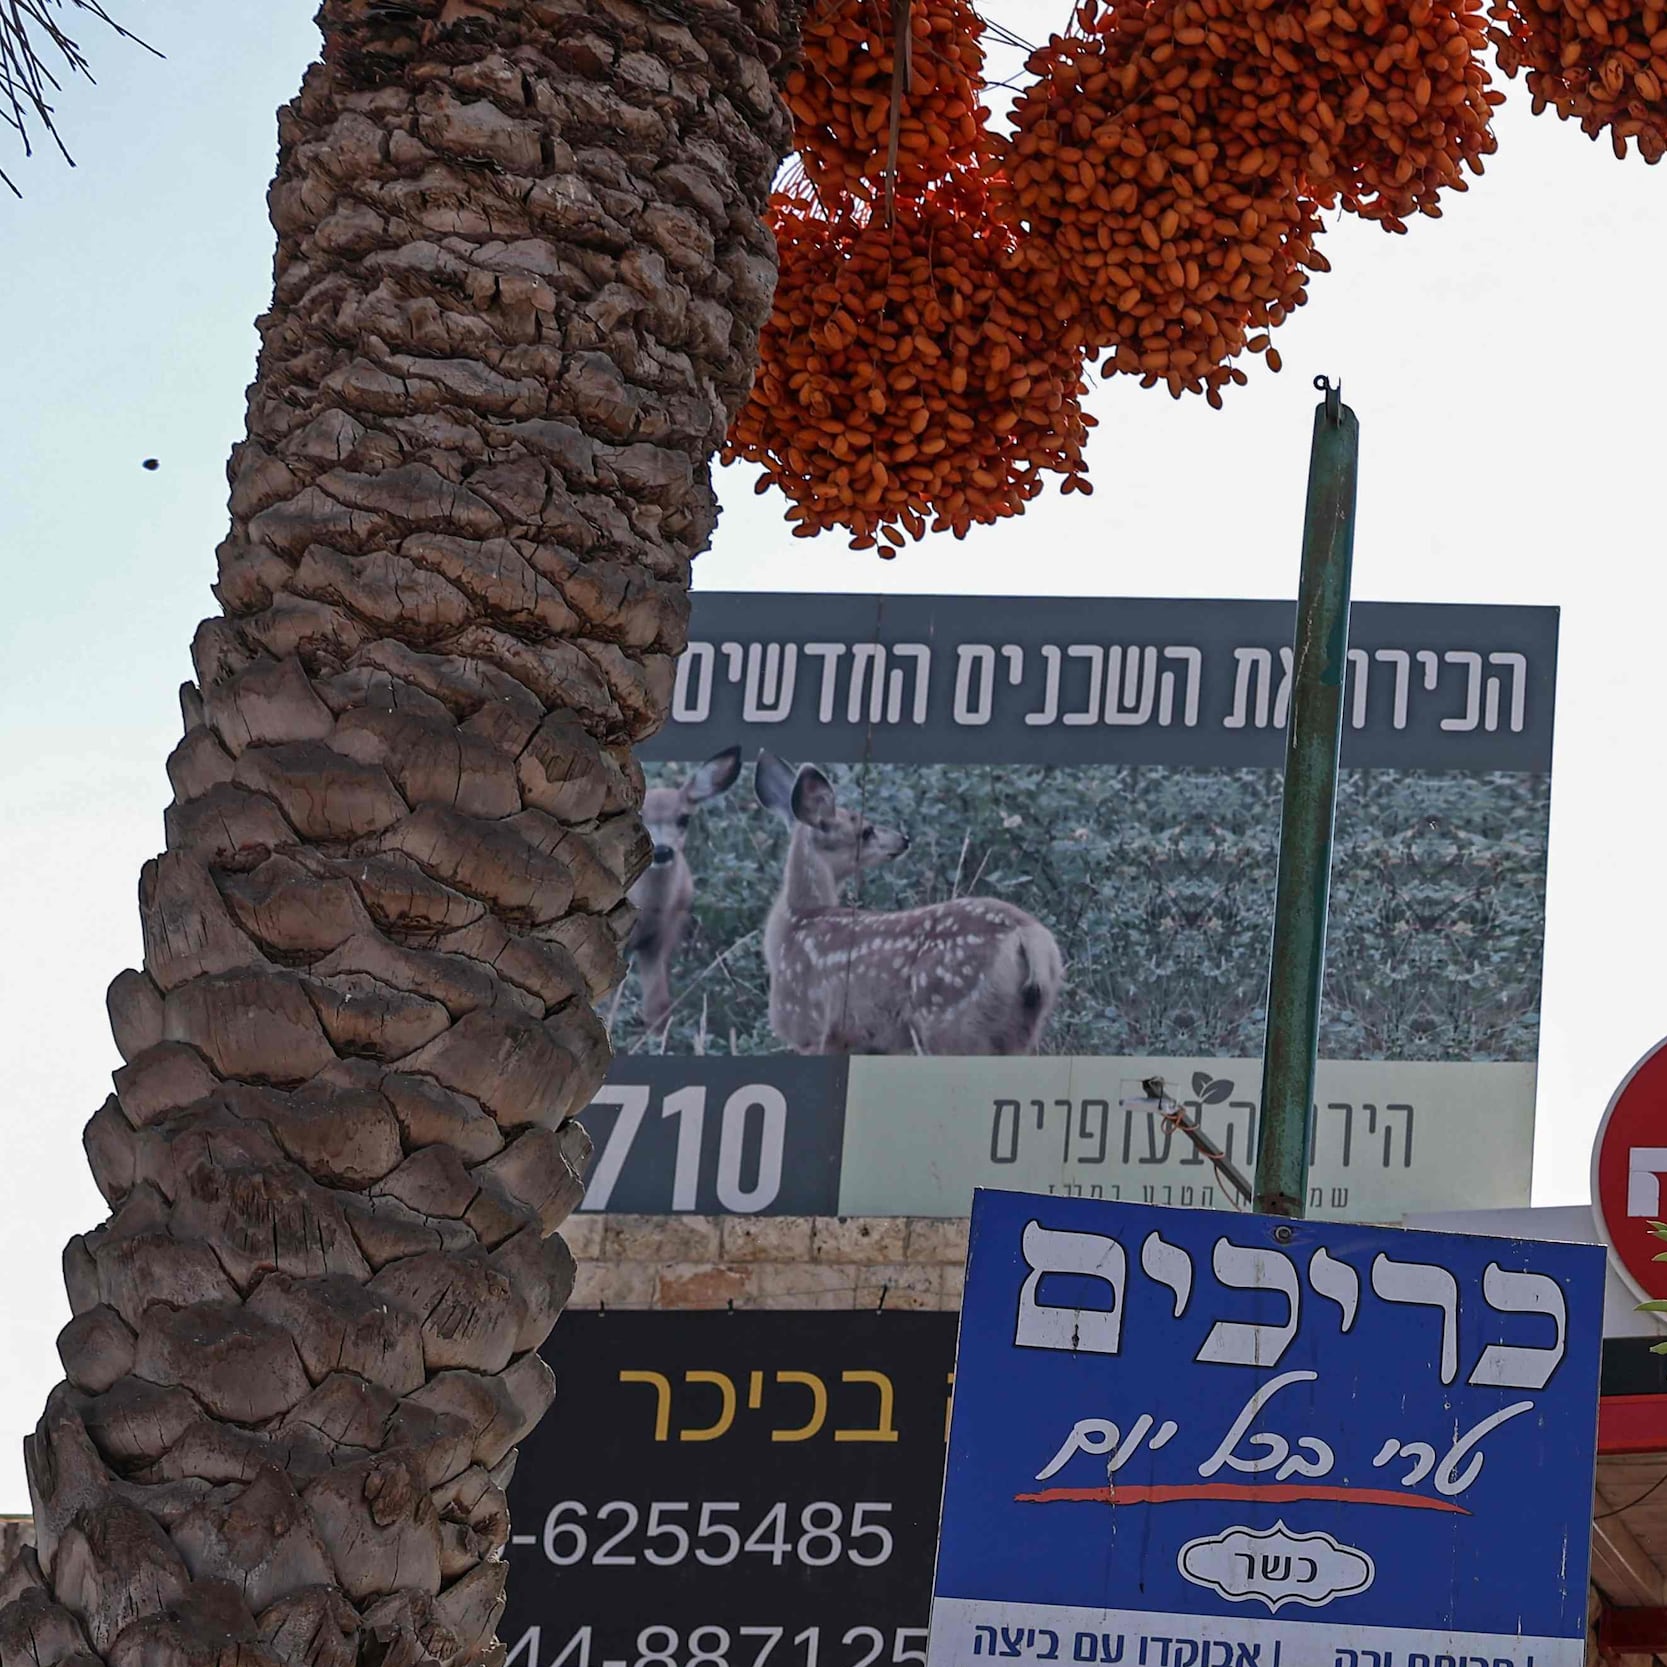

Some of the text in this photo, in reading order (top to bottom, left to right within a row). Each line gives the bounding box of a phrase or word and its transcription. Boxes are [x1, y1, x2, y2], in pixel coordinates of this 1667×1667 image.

[671, 641, 932, 725] החדשים
[953, 643, 1203, 728] השכנים
[1346, 647, 1527, 733] הכירו
[580, 1083, 788, 1214] 710
[1013, 1218, 1567, 1390] כריכים
[619, 1370, 899, 1443] בכיכר
[1035, 1369, 1535, 1496] טרי בכל יום
[1234, 1552, 1319, 1583] כשר
[972, 1624, 1060, 1661] ביצה
[1072, 1630, 1125, 1664] עם
